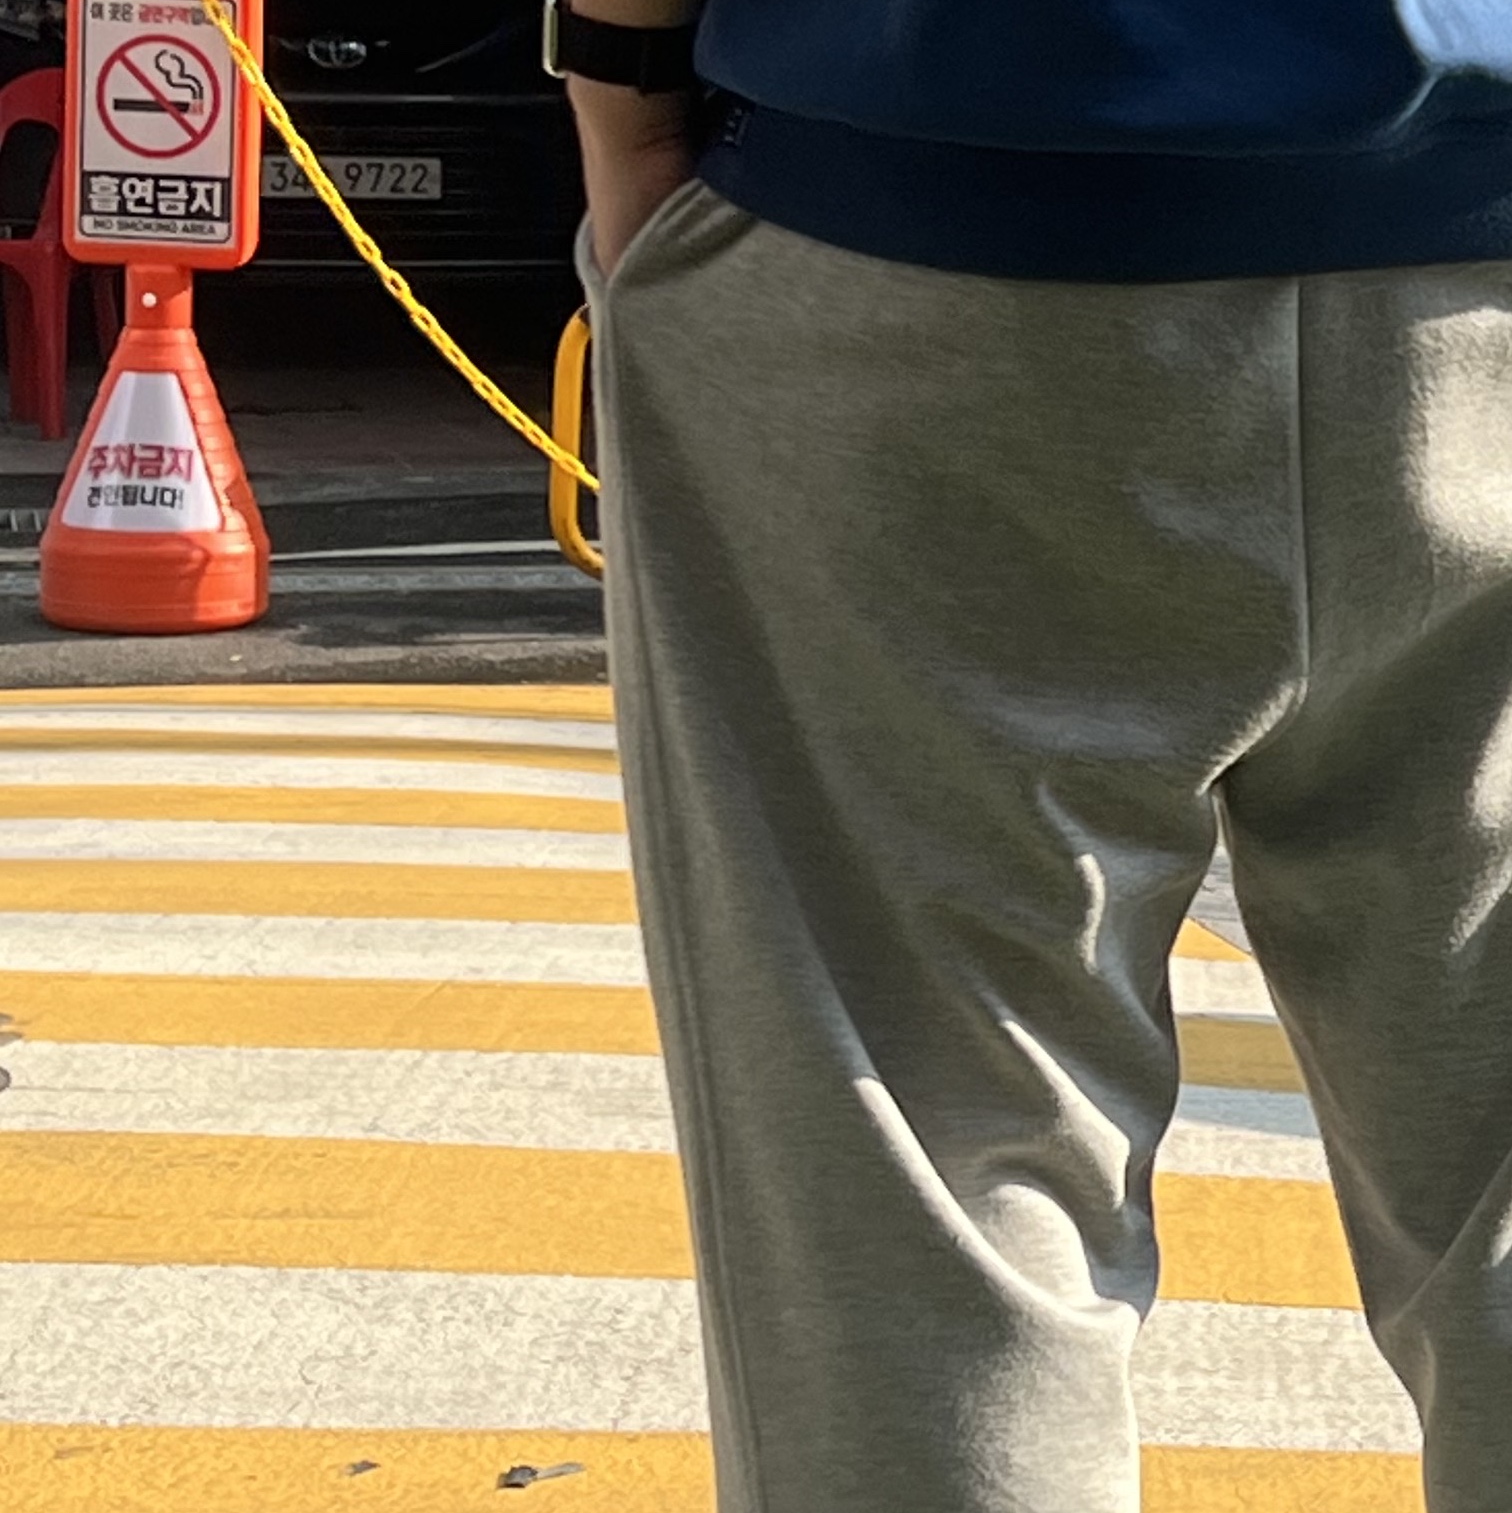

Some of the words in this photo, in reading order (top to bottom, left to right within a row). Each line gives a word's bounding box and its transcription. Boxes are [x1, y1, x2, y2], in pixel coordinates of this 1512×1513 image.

[139, 3, 220, 27] 금연구역입
[344, 162, 429, 195] 9722
[88, 175, 222, 218] 흡연금지
[93, 217, 113, 230] NO
[116, 219, 179, 234] SMOKING
[181, 223, 216, 235] AREA
[87, 443, 193, 483] 주차금지
